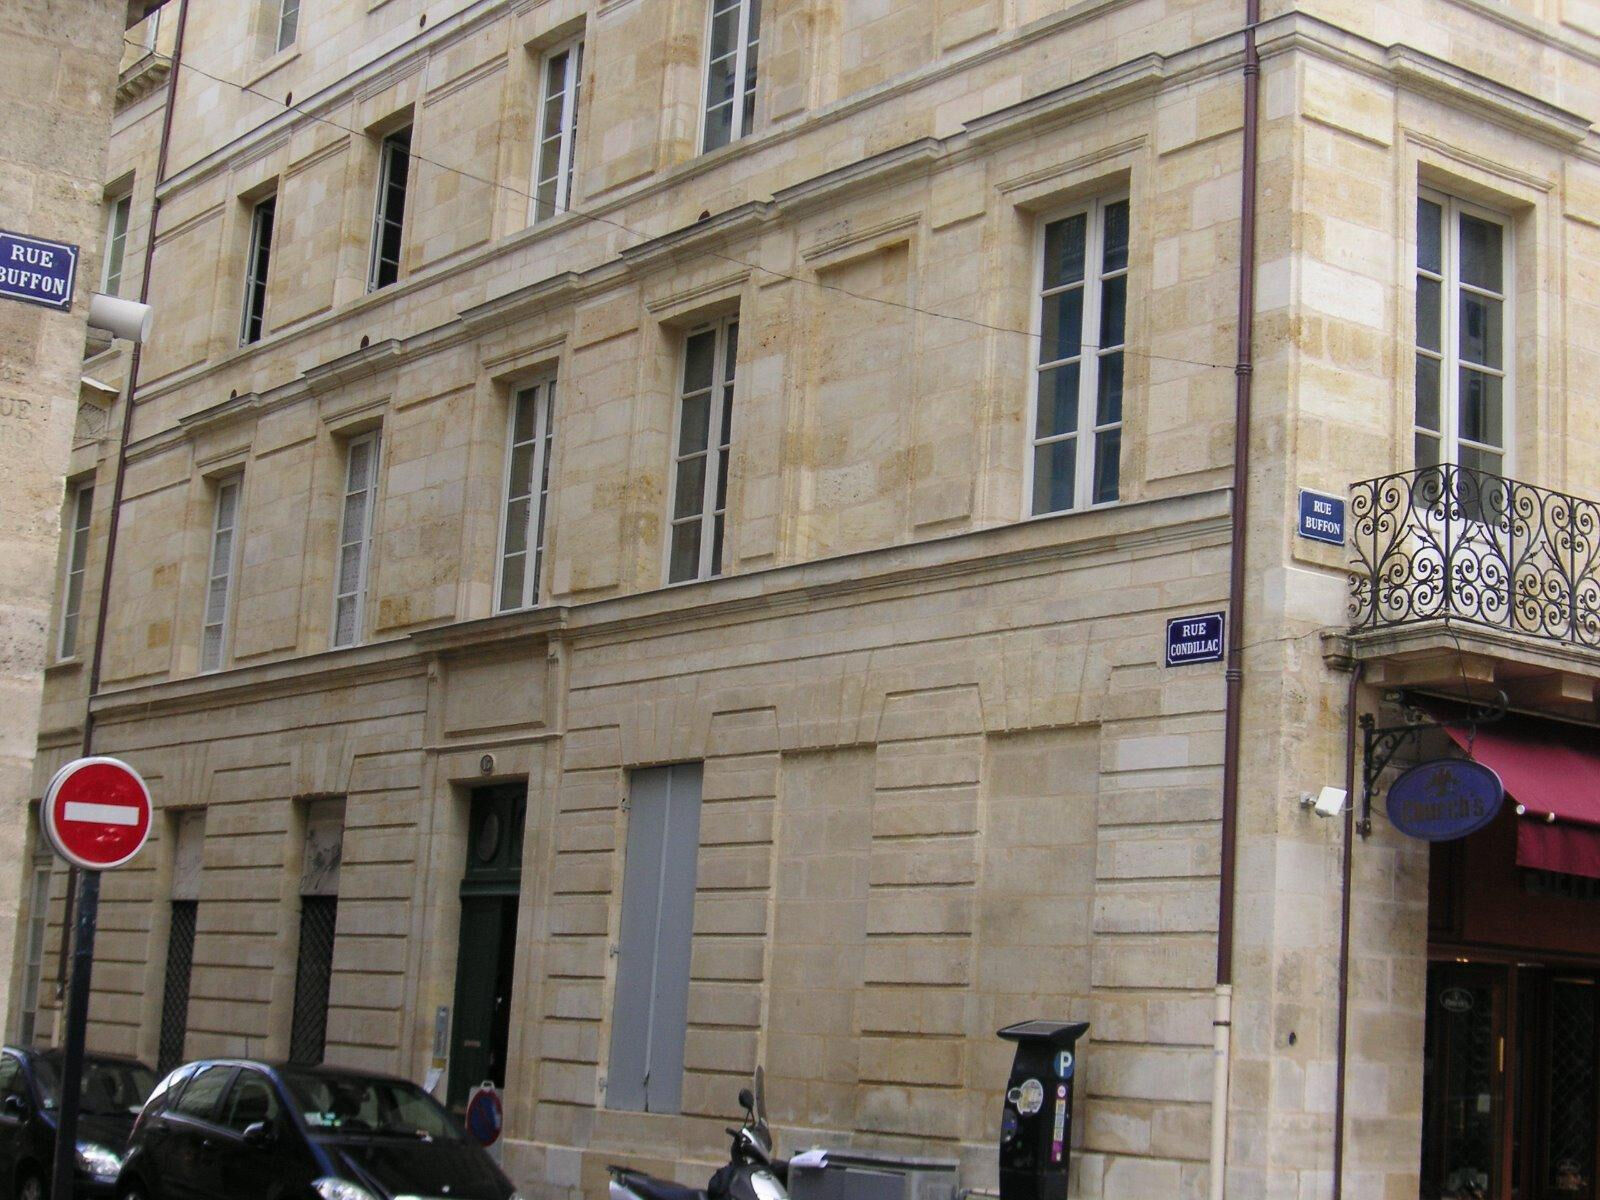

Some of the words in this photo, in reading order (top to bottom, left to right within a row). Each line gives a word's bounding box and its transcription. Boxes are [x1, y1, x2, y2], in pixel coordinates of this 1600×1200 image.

[10, 244, 54, 268] RUE
[0, 266, 65, 295] BUFFON
[1313, 500, 1332, 515] RUE
[1305, 516, 1341, 535] BUFFON
[1182, 622, 1207, 637] RUE
[1170, 638, 1219, 656] CONDILLAC
[1060, 1051, 1072, 1077] P
